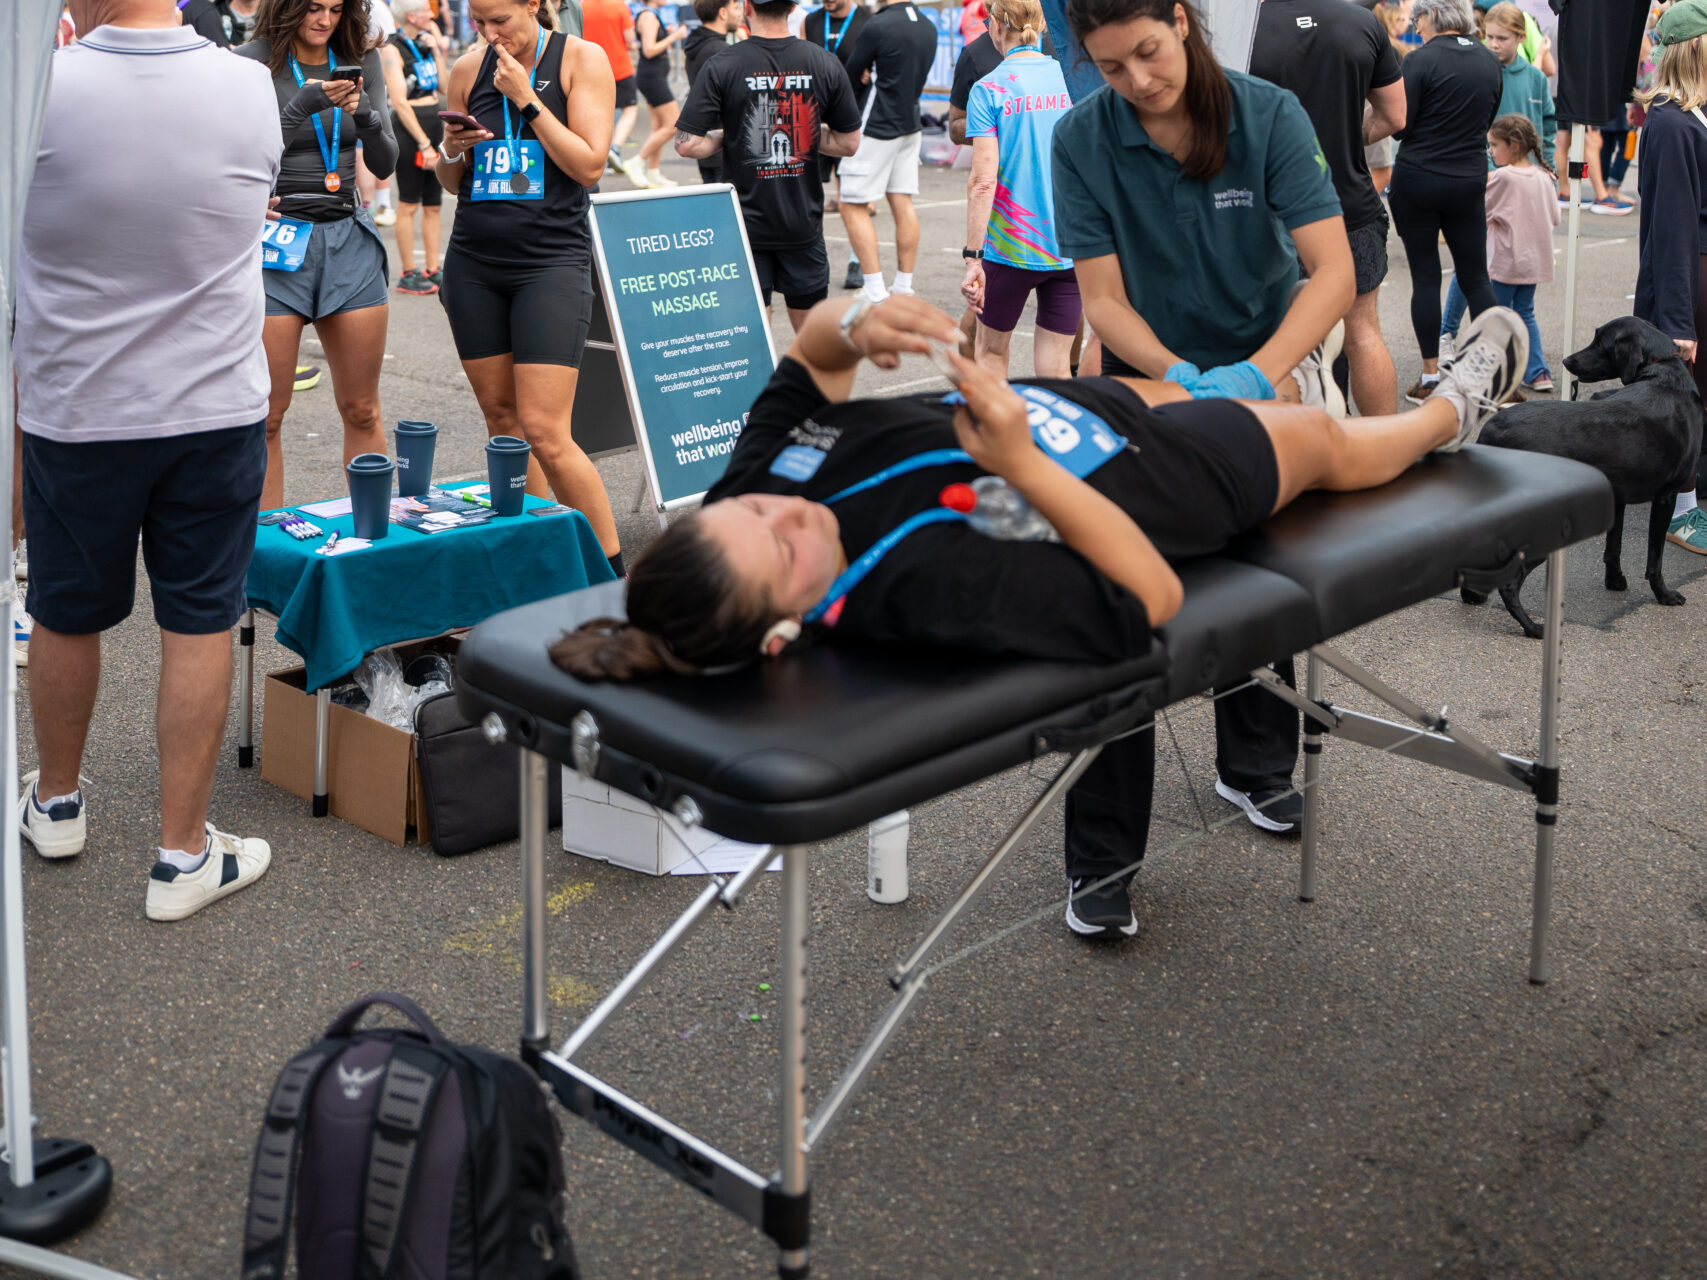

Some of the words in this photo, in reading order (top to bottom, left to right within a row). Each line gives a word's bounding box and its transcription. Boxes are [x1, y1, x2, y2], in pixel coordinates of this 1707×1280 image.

[1003, 93, 1074, 116] STEAME
[625, 233, 671, 255] TIRED
[672, 227, 715, 250] LEGS?
[619, 274, 657, 296] FREE
[658, 262, 741, 290] POST-RACE
[651, 290, 720, 318] MASSAGE
[640, 341, 655, 351] Give
[655, 339, 670, 350] your
[670, 334, 695, 345] muscles
[694, 332, 706, 341] the
[706, 327, 734, 339] recovery
[733, 324, 749, 334] they
[662, 346, 689, 359] deserve
[688, 344, 704, 354] after
[704, 341, 715, 351] the
[715, 339, 732, 349] race.
[654, 372, 678, 383] Reduce
[678, 367, 700, 378] muscle
[699, 362, 725, 374] tension,
[724, 357, 750, 370] improve
[660, 381, 693, 394] circulation
[692, 376, 705, 387] and
[705, 371, 734, 384] kick-start
[734, 368, 749, 380] your
[693, 385, 723, 399] recovery.
[671, 418, 742, 448] wellbeing
[675, 445, 706, 466] that
[705, 436, 738, 458] work
